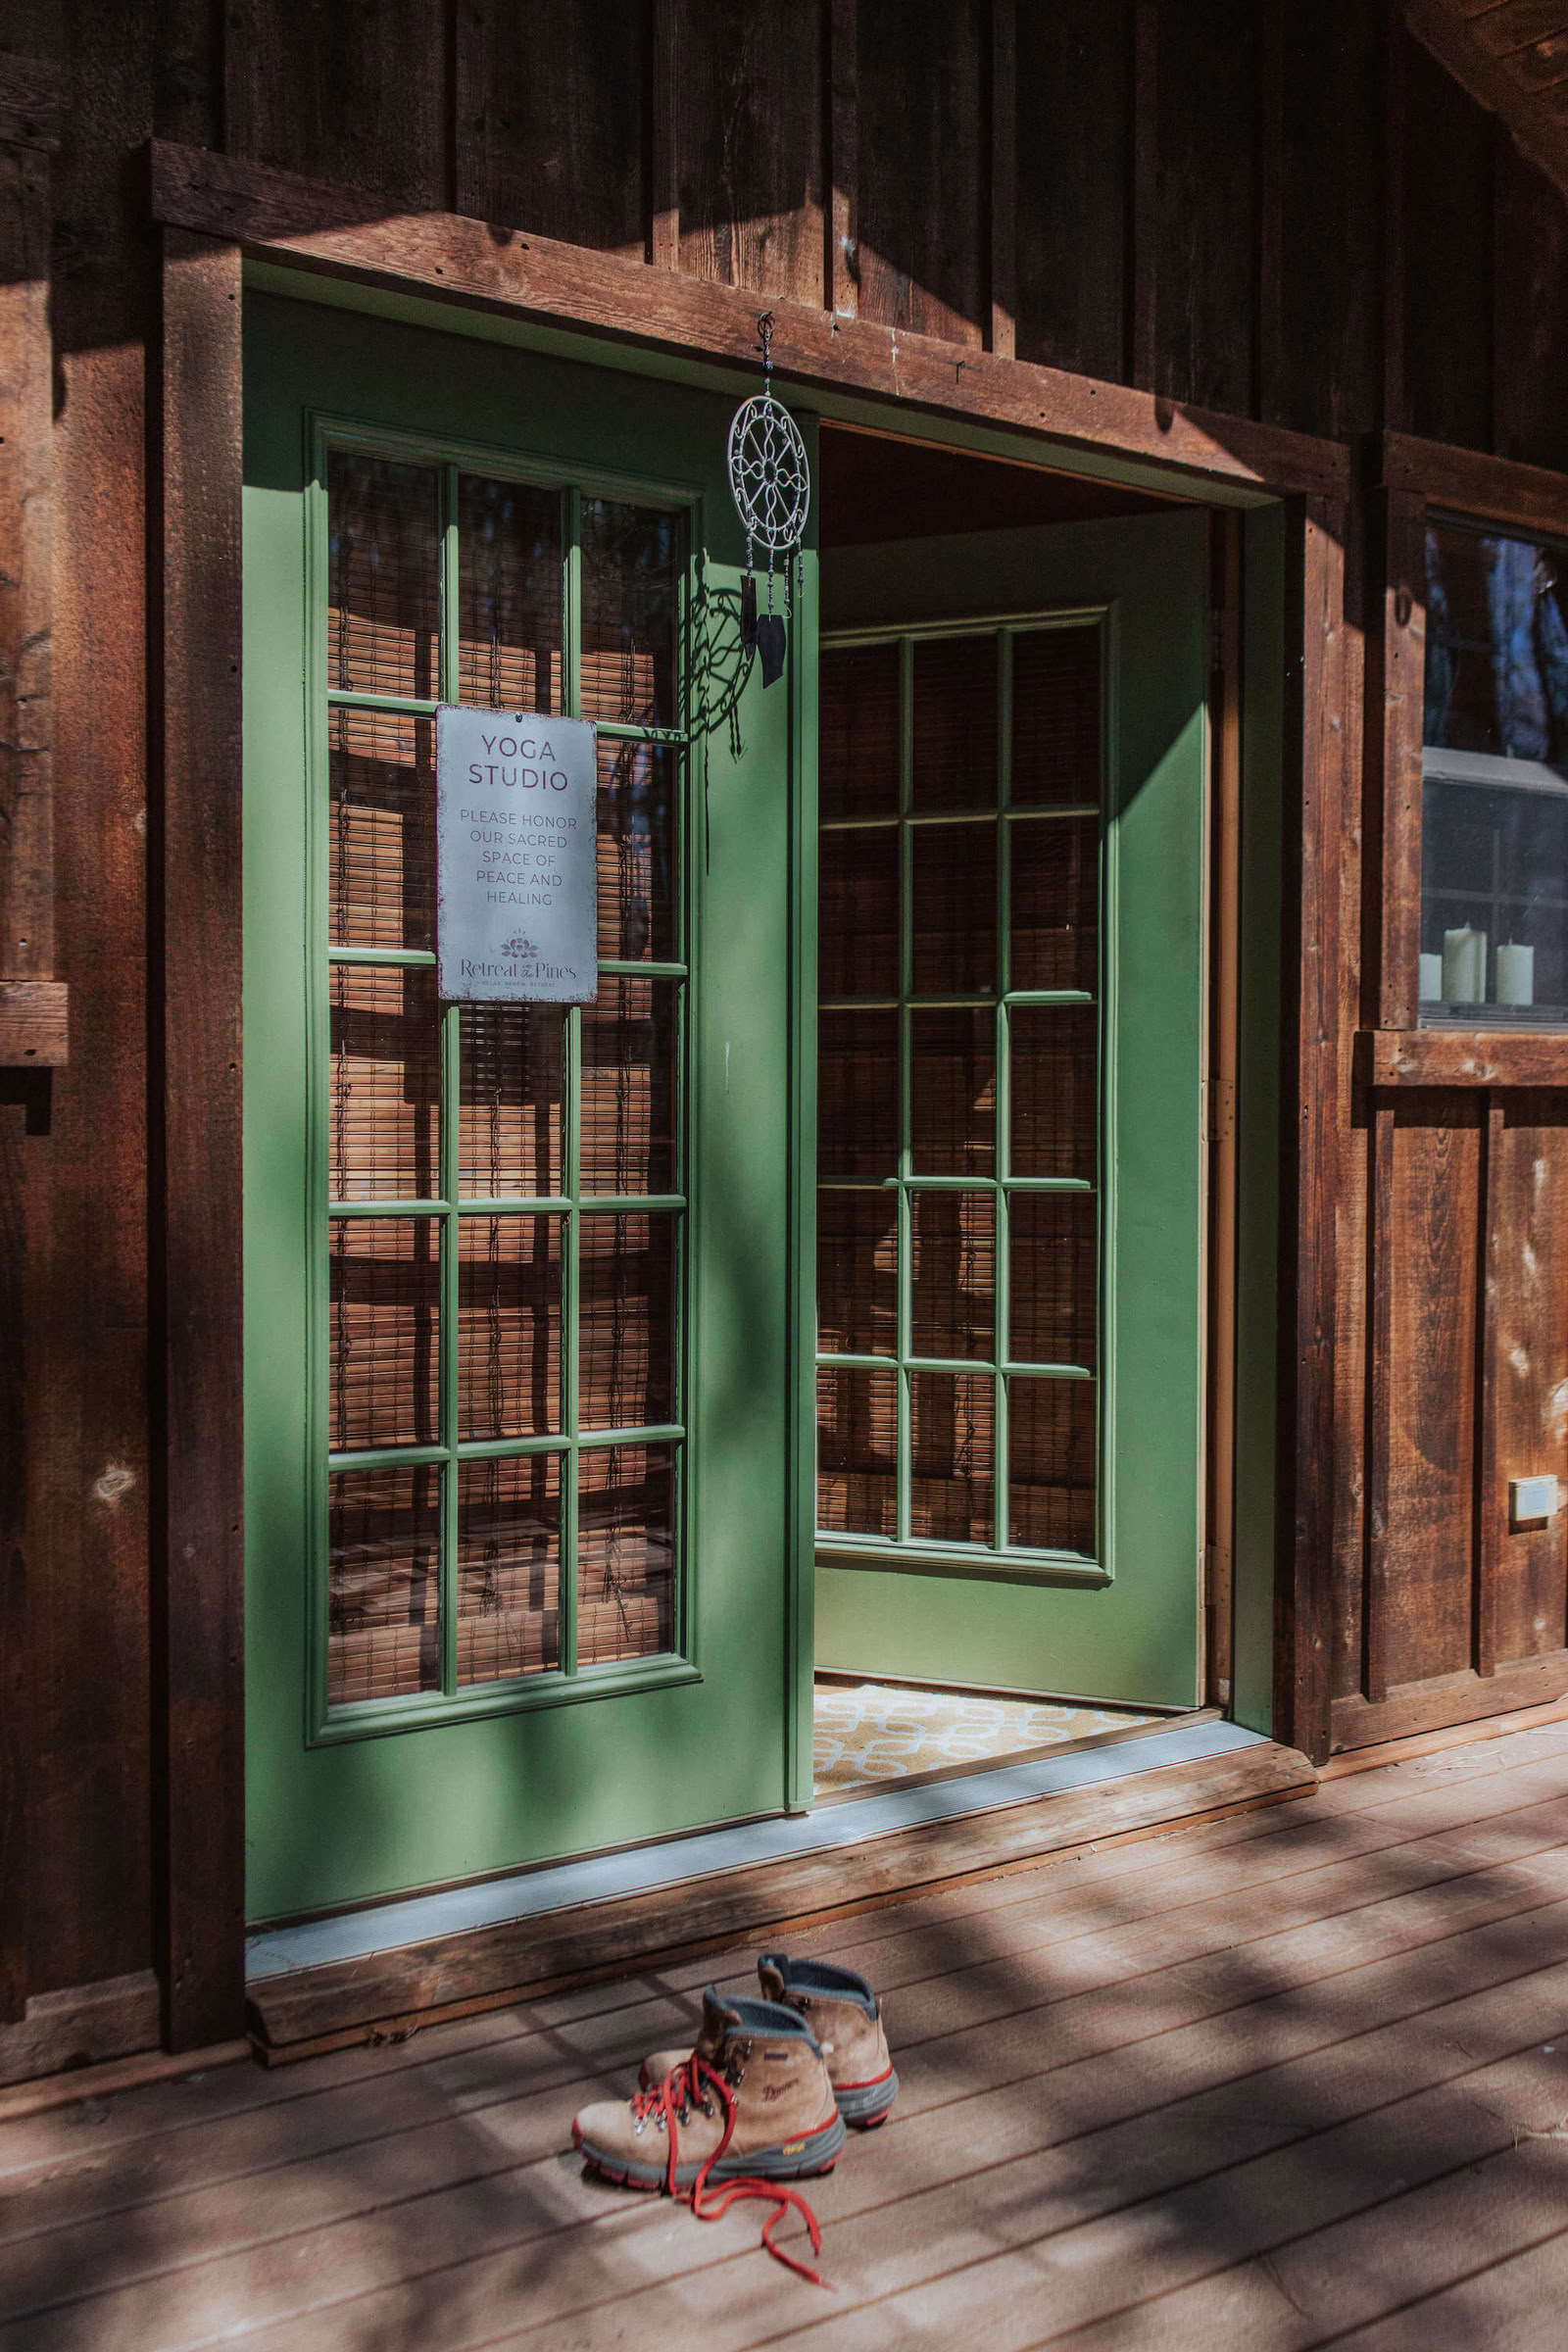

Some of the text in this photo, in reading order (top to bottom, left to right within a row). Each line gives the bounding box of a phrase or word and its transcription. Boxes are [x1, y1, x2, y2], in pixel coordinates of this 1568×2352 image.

[481, 734, 557, 761] YOGA
[468, 763, 568, 792] STUDIO
[460, 808, 577, 830] PLEASE HONOR
[469, 830, 567, 849] OUR SACRED
[482, 851, 556, 867] SPACE OF
[476, 869, 563, 887] PEACE AND
[486, 890, 552, 906] HEALING
[461, 958, 517, 978] Retreat
[535, 961, 577, 980] Pines
